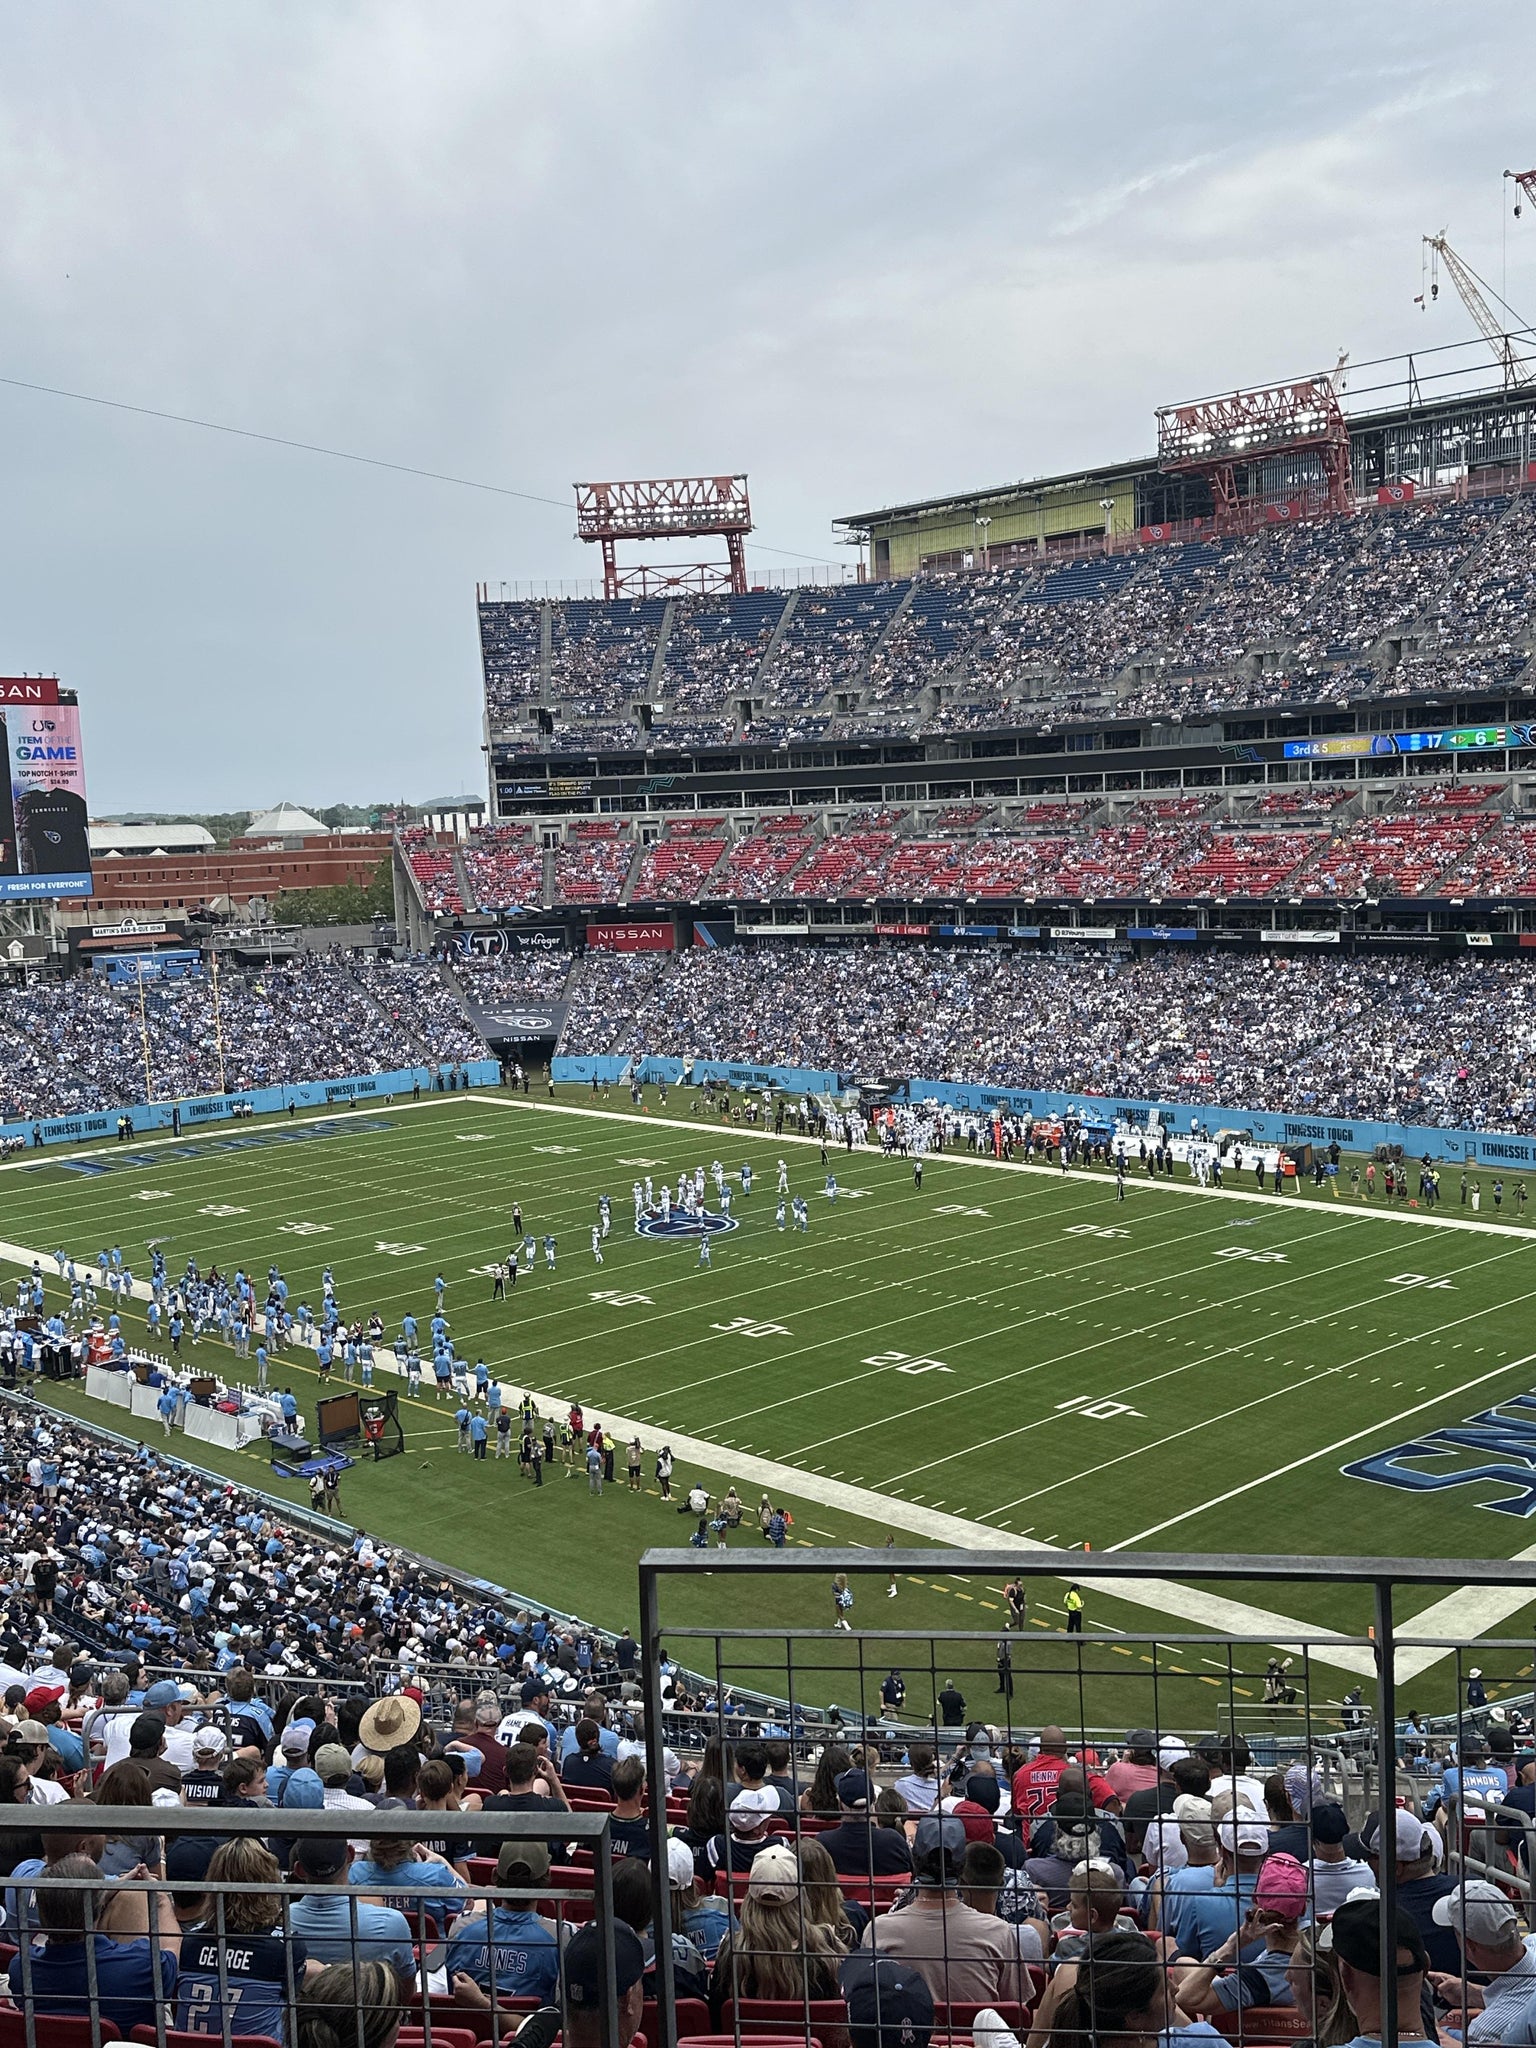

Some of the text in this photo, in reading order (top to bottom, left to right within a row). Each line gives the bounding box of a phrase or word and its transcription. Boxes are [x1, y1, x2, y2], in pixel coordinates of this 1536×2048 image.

[18, 736, 42, 744] ITEM
[1427, 734, 1443, 749] 17
[1475, 732, 1487, 745] 6
[16, 746, 76, 760] GAME
[1293, 745, 1310, 755] 3rd
[1312, 744, 1321, 754] &
[1321, 743, 1329, 753] 5
[8, 883, 30, 891] FRESH
[31, 882, 46, 890] FOR
[598, 929, 663, 940] NISSAN
[325, 1081, 376, 1096] TENNESSEE TOUGH
[189, 1101, 223, 1116] TENNESSEE
[44, 1118, 107, 1137] TENNESSEE TOUGH
[1327, 1127, 1353, 1142] TOUGH
[1482, 1142, 1530, 1160] TENNESSEE
[588, 1290, 650, 1307] 40
[709, 1317, 788, 1338] 30
[860, 1351, 948, 1375] 20
[1054, 1395, 1136, 1420] 10
[580, 1645, 588, 1655] 13
[1031, 1770, 1058, 1783] HENRY
[1463, 1774, 1500, 1787] SIMMONS
[199, 1946, 253, 1970] GERGE
